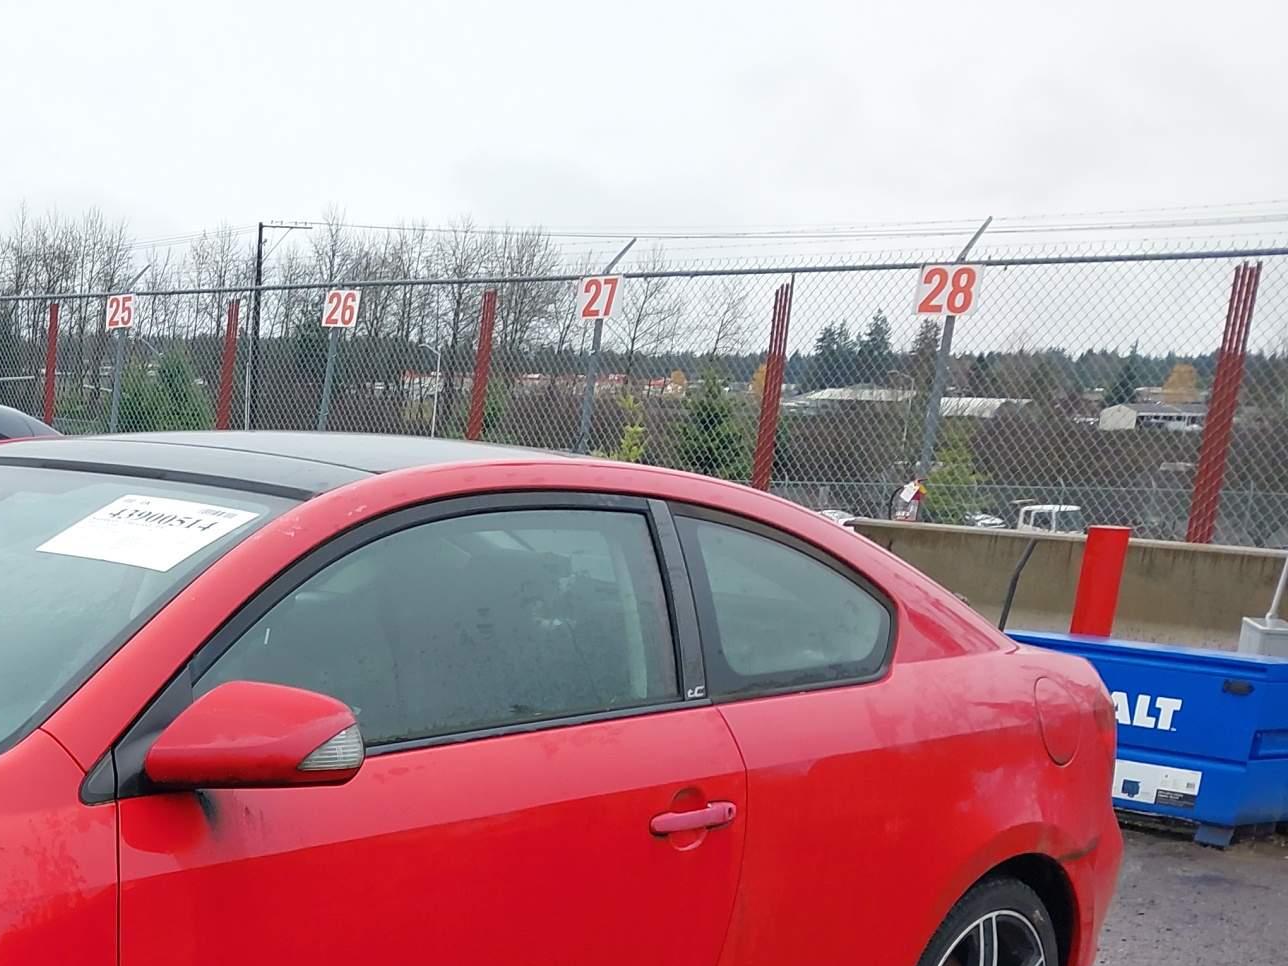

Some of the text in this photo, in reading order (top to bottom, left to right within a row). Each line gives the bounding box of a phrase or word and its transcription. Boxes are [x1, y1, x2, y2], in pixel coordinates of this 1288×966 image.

[582, 278, 618, 318] 27
[917, 267, 977, 315] 28
[108, 296, 132, 327] 25
[325, 292, 355, 325] 26
[109, 508, 218, 531] 43900514
